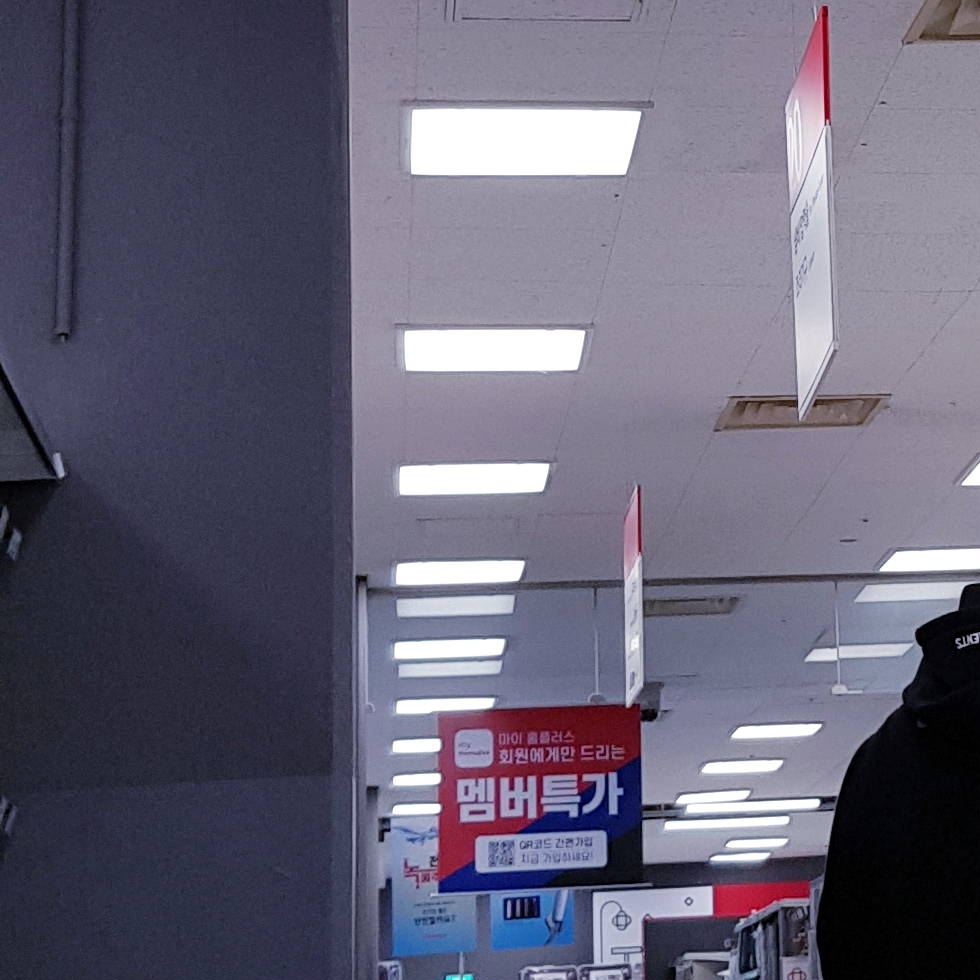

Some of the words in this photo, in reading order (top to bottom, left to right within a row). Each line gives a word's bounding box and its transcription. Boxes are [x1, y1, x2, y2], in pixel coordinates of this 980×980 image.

[498, 732, 523, 745] 마이
[498, 747, 575, 764] 회원에게만
[580, 744, 626, 761] 드리는
[456, 772, 625, 824] 멤버특가
[519, 839, 552, 850] QR코드
